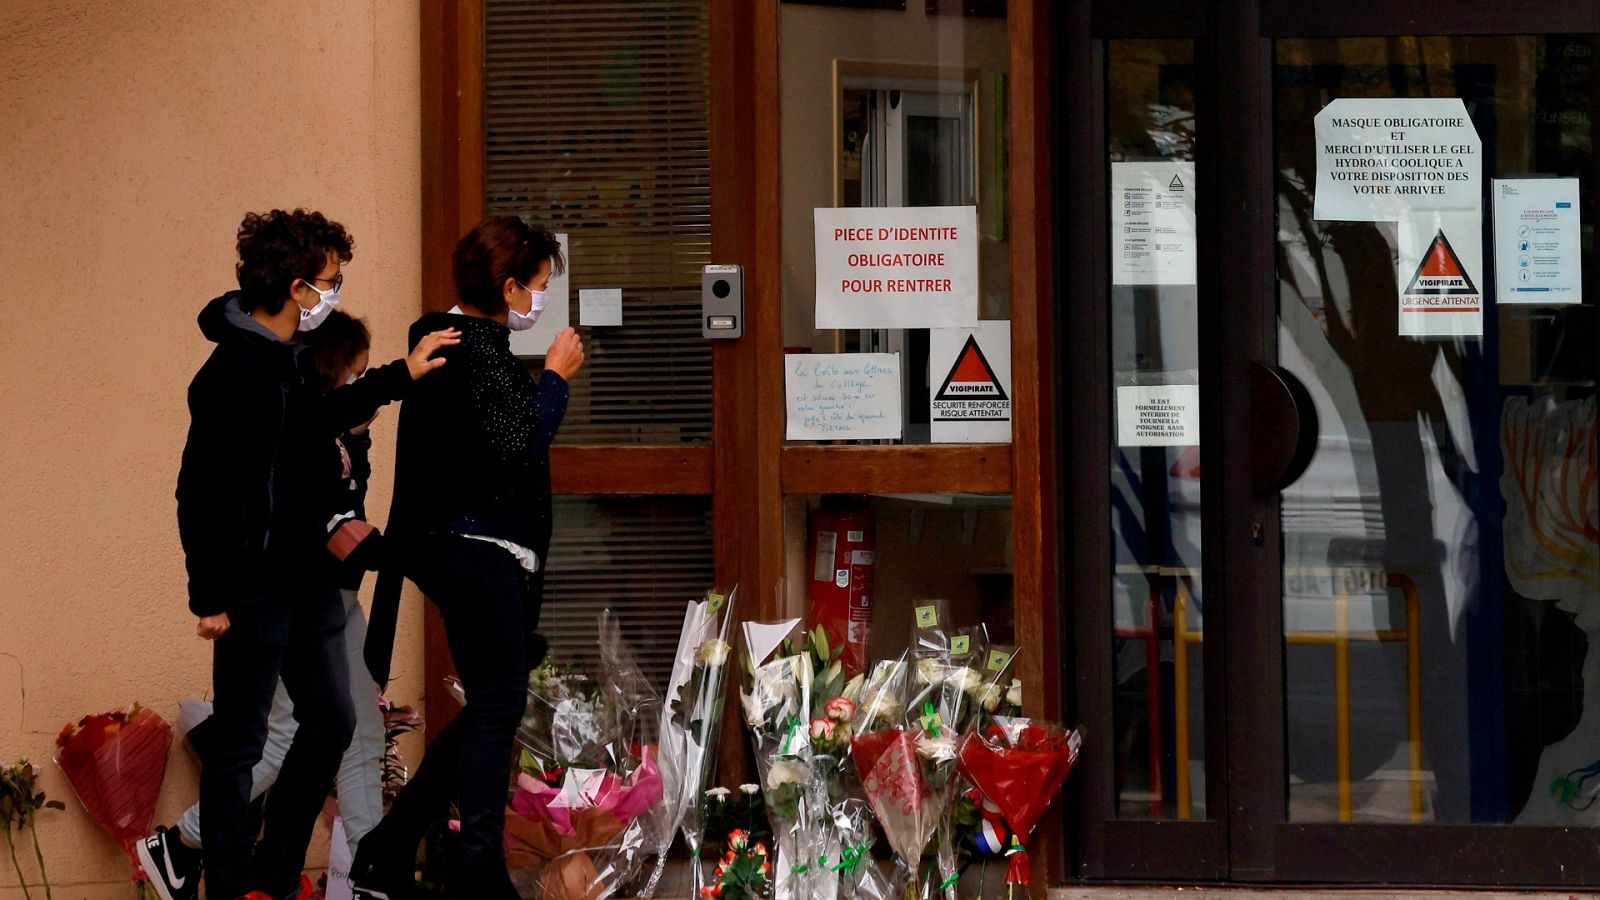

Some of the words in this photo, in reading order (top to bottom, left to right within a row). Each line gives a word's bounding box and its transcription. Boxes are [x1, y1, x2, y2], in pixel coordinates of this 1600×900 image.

[1332, 118, 1381, 129] MASQUE
[1384, 118, 1464, 128] OBLIGATOIRE
[1390, 132, 1406, 141] ET
[1325, 145, 1361, 154] MERCI
[1364, 145, 1430, 154] D'UTILISER
[1433, 145, 1447, 154] LE
[1450, 145, 1474, 154] GEL
[1335, 158, 1452, 169] HYDROALCOOLIQUE
[1454, 159, 1463, 168] A
[1330, 172, 1369, 181] VOTRE
[1371, 172, 1444, 181] DISPOSITION
[1447, 172, 1469, 181] DES
[1353, 185, 1392, 195] VOTRE
[1394, 185, 1446, 195] ARRIVEE
[834, 228, 873, 241] PIECE
[878, 227, 957, 241] D'IDENTITE
[847, 253, 945, 267] OBLIGATOIRE
[842, 279, 882, 292] POUR
[887, 279, 952, 292] RENTRER
[1401, 297, 1440, 305] URGENCE
[1441, 297, 1480, 305] ATTENTAT
[933, 401, 966, 409] SECURITE
[968, 401, 1010, 409] RENFORCEE
[940, 409, 967, 417] RISQUE
[969, 409, 1003, 417] ATTENTAT
